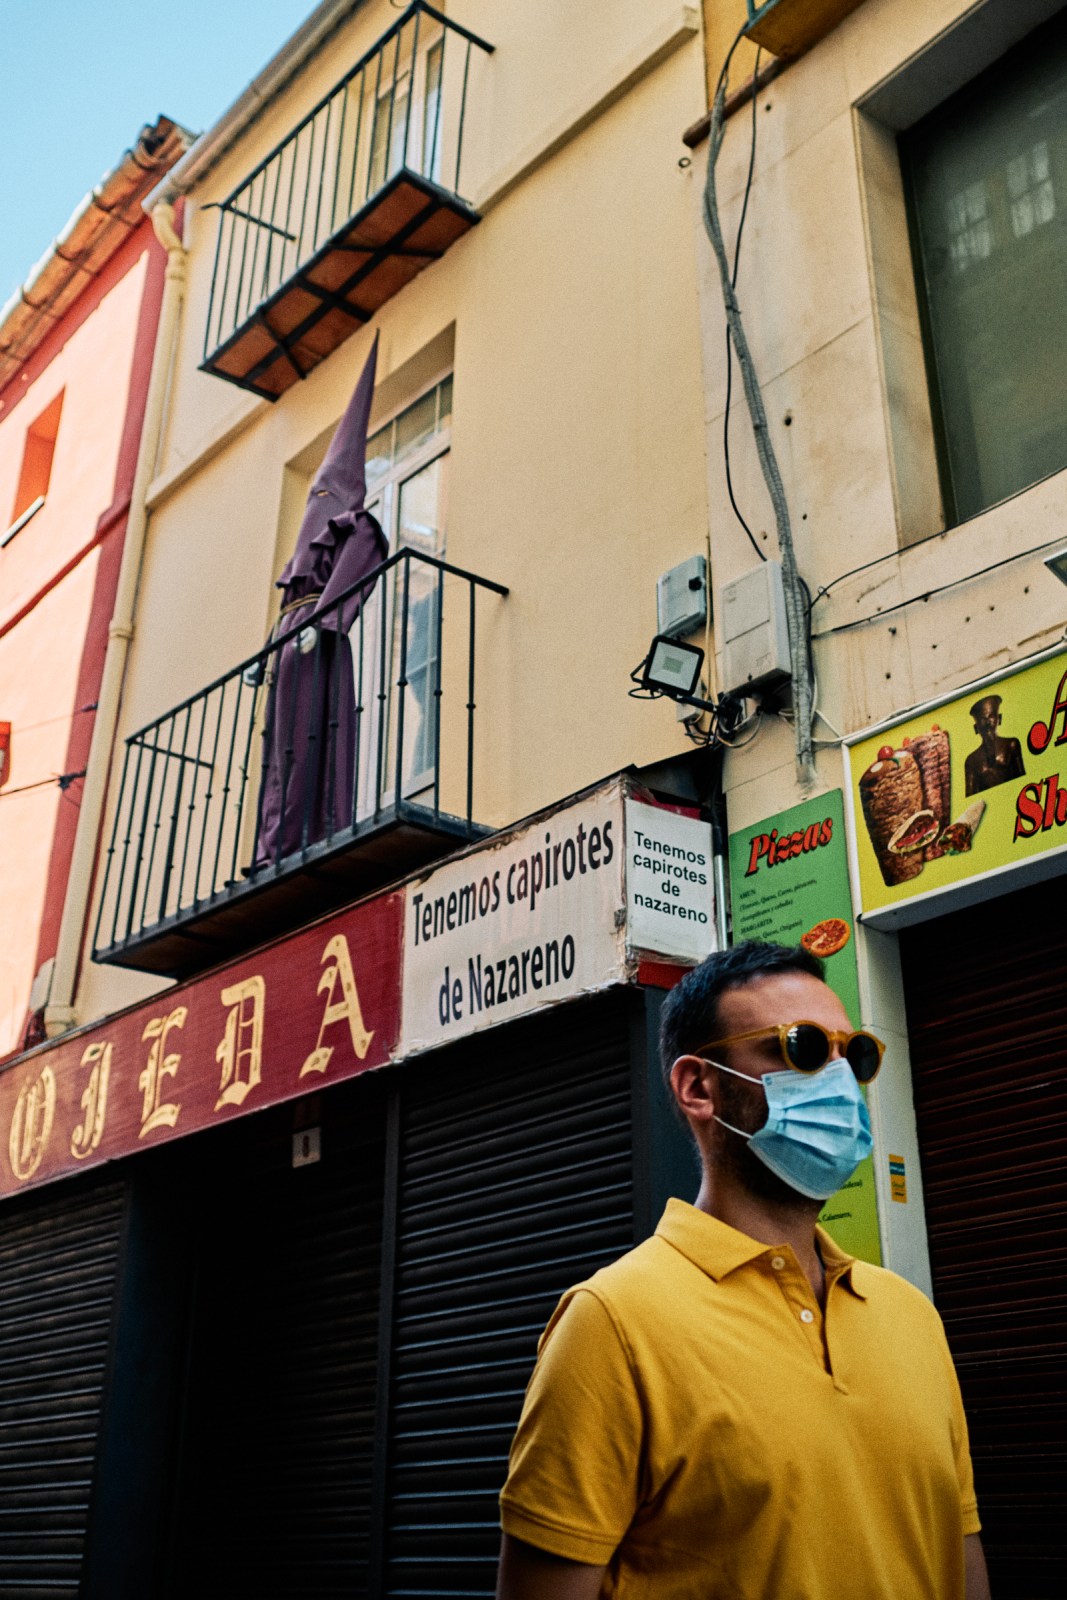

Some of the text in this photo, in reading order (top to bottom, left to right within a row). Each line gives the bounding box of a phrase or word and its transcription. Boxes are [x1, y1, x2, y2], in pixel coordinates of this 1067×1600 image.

[633, 831, 706, 866] Tenemos
[633, 854, 707, 885] capirotes
[744, 817, 833, 878] Pizzas
[413, 820, 614, 946] Tenemos capirotes
[661, 880, 680, 897] de
[634, 893, 708, 924] nazareno
[439, 934, 575, 1026] de Nazareno
[9, 934, 375, 1180] OJEDA
